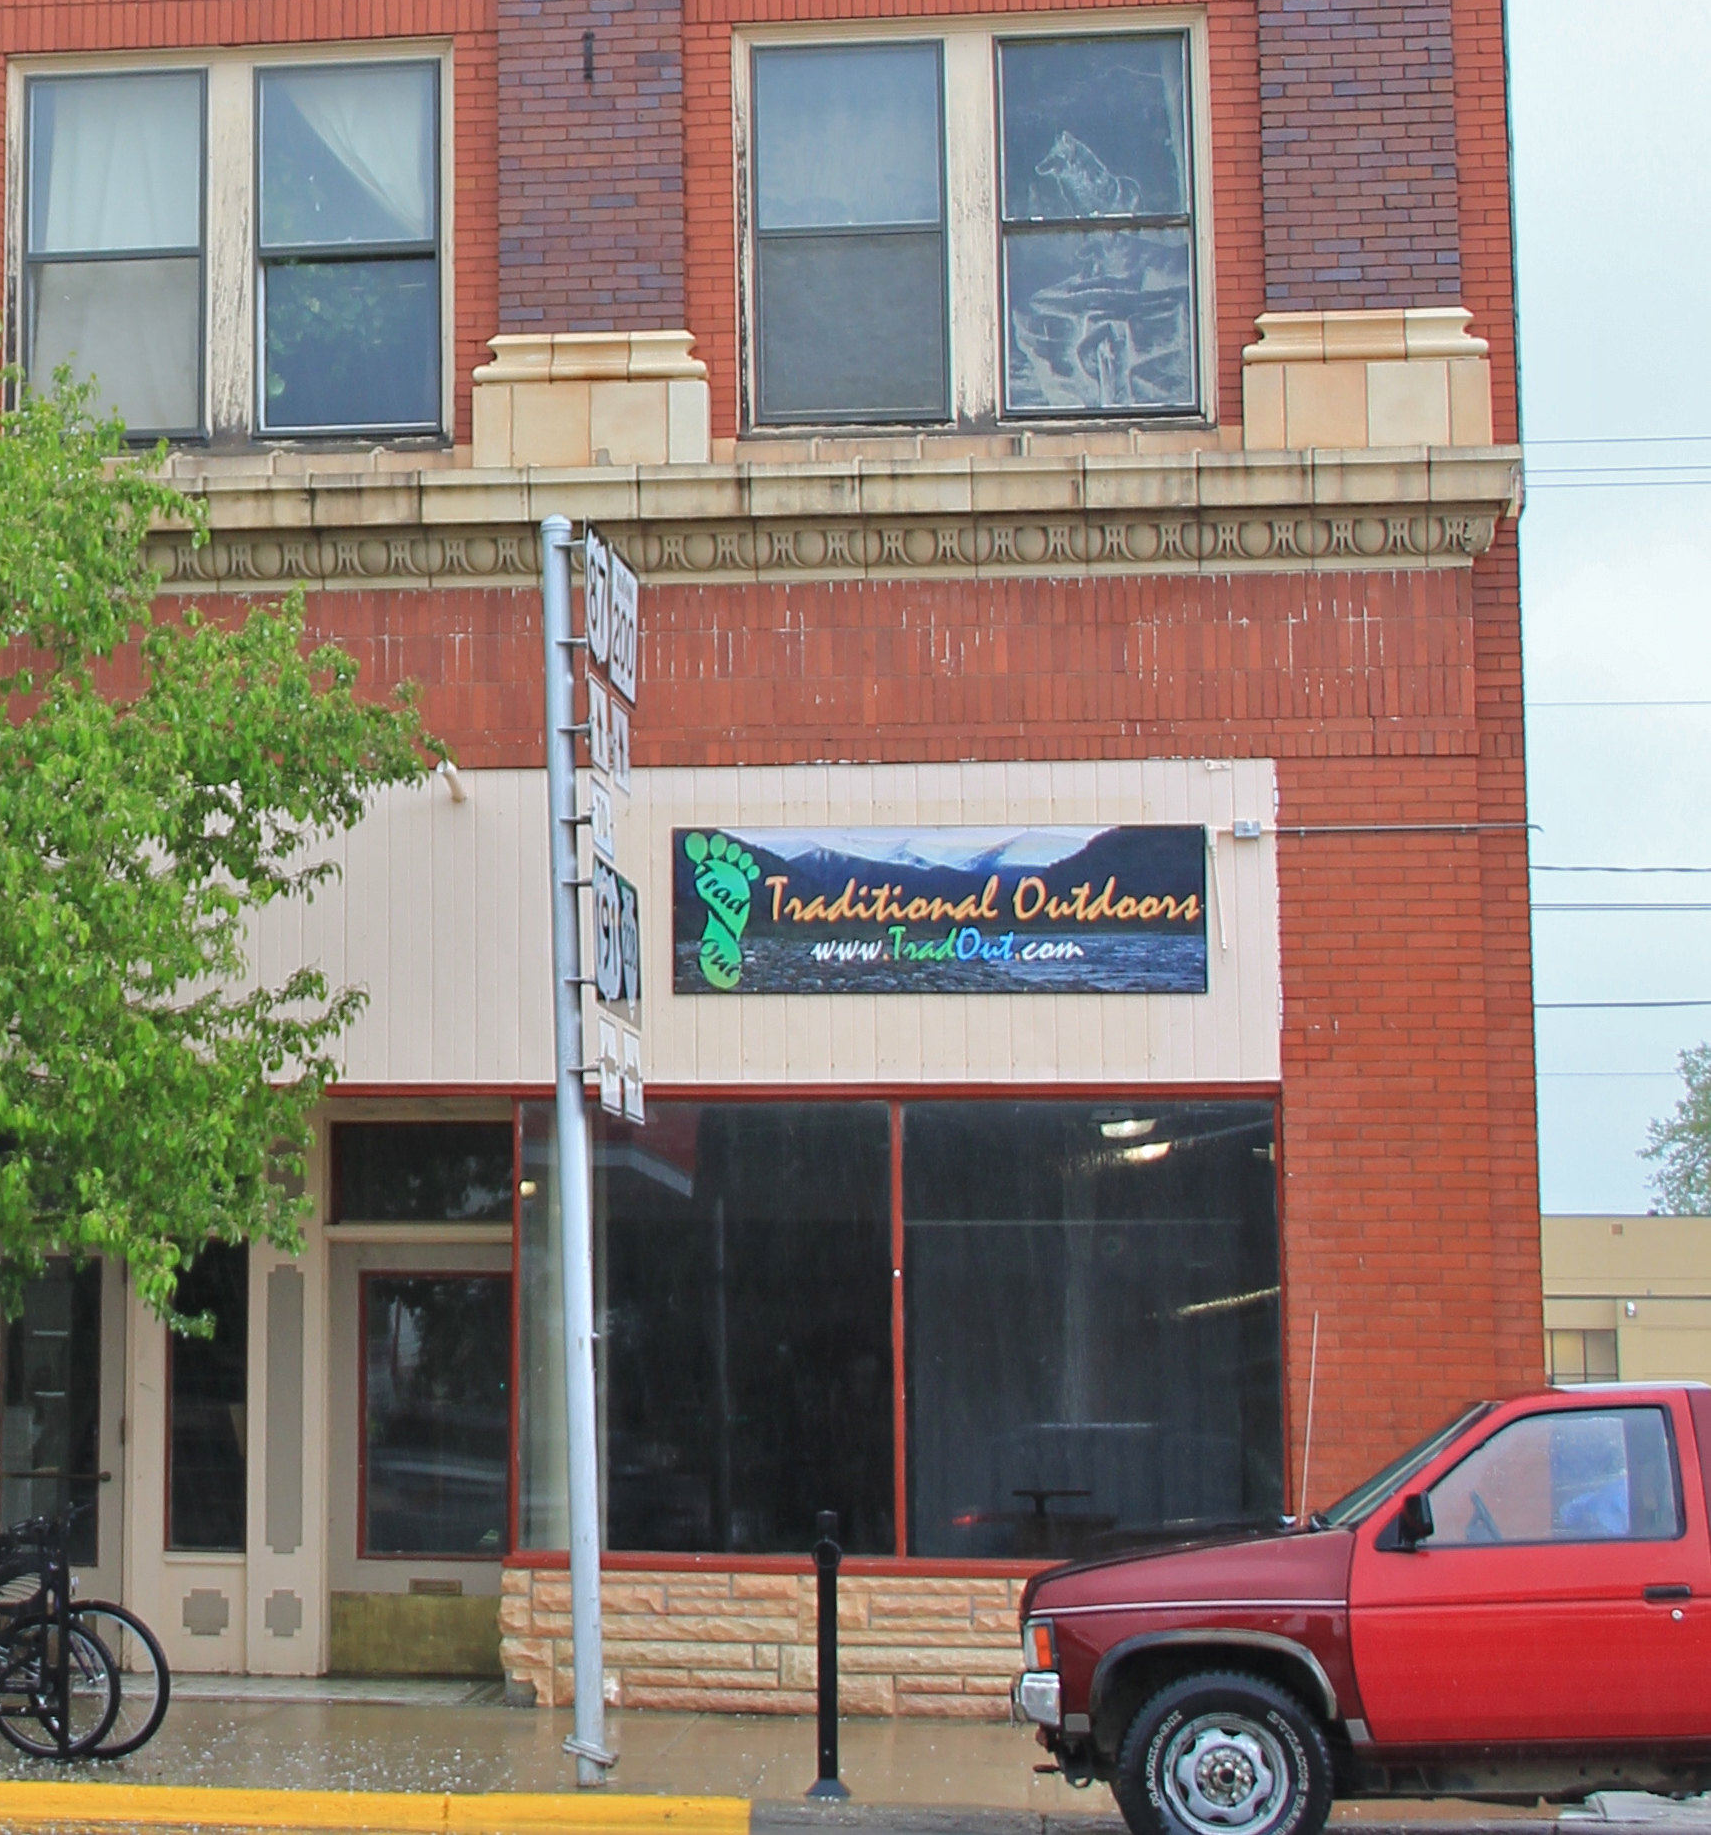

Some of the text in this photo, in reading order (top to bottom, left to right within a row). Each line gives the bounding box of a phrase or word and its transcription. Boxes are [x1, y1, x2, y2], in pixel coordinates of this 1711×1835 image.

[589, 553, 606, 641] 87
[613, 600, 635, 681] 200
[693, 863, 750, 916] Trad
[764, 874, 1200, 923] Traditional Outdoors
[809, 925, 1084, 962] www.TradOut.com
[1146, 1709, 1183, 1808] HANKOOK
